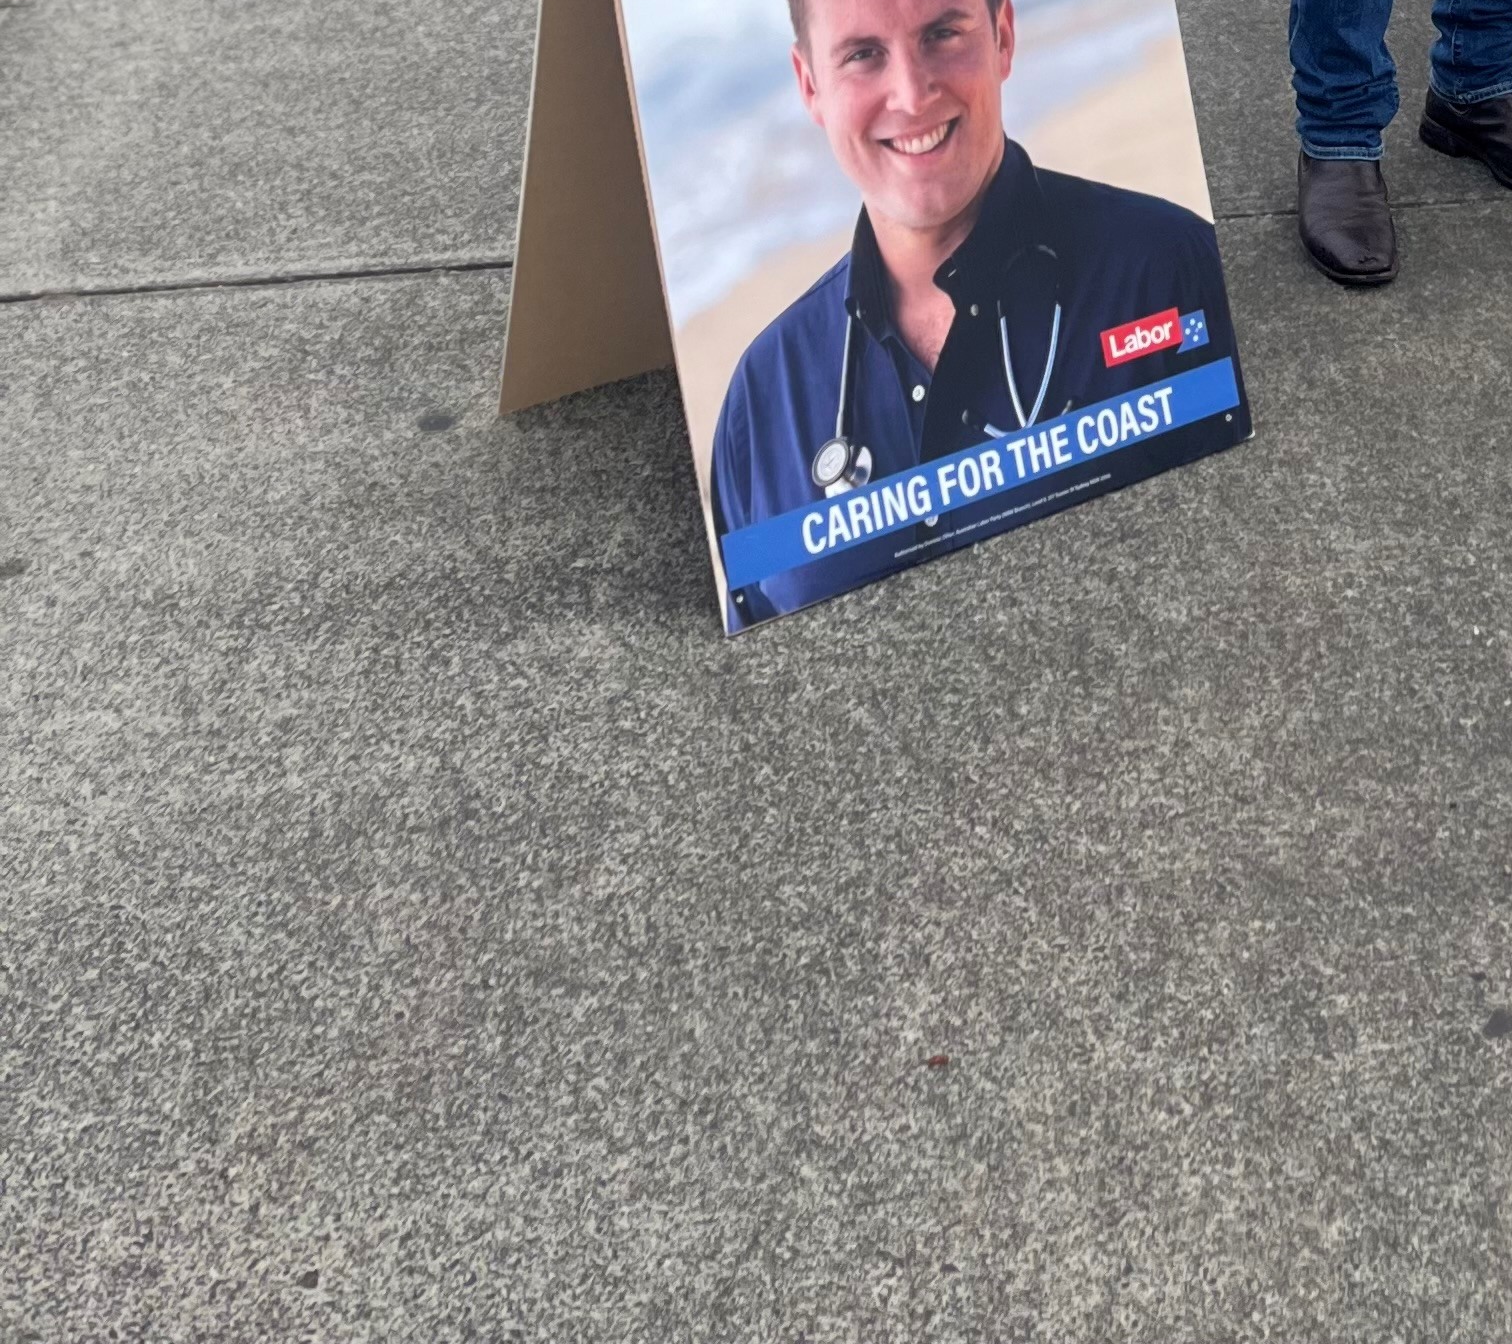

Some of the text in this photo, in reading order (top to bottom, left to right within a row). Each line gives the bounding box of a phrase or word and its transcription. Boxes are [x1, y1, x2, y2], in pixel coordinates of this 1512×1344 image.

[1109, 320, 1173, 359] Labor
[802, 484, 931, 554] CARING
[937, 450, 1005, 505] FOR
[1007, 424, 1073, 479] THE
[1076, 387, 1175, 455] COAST
